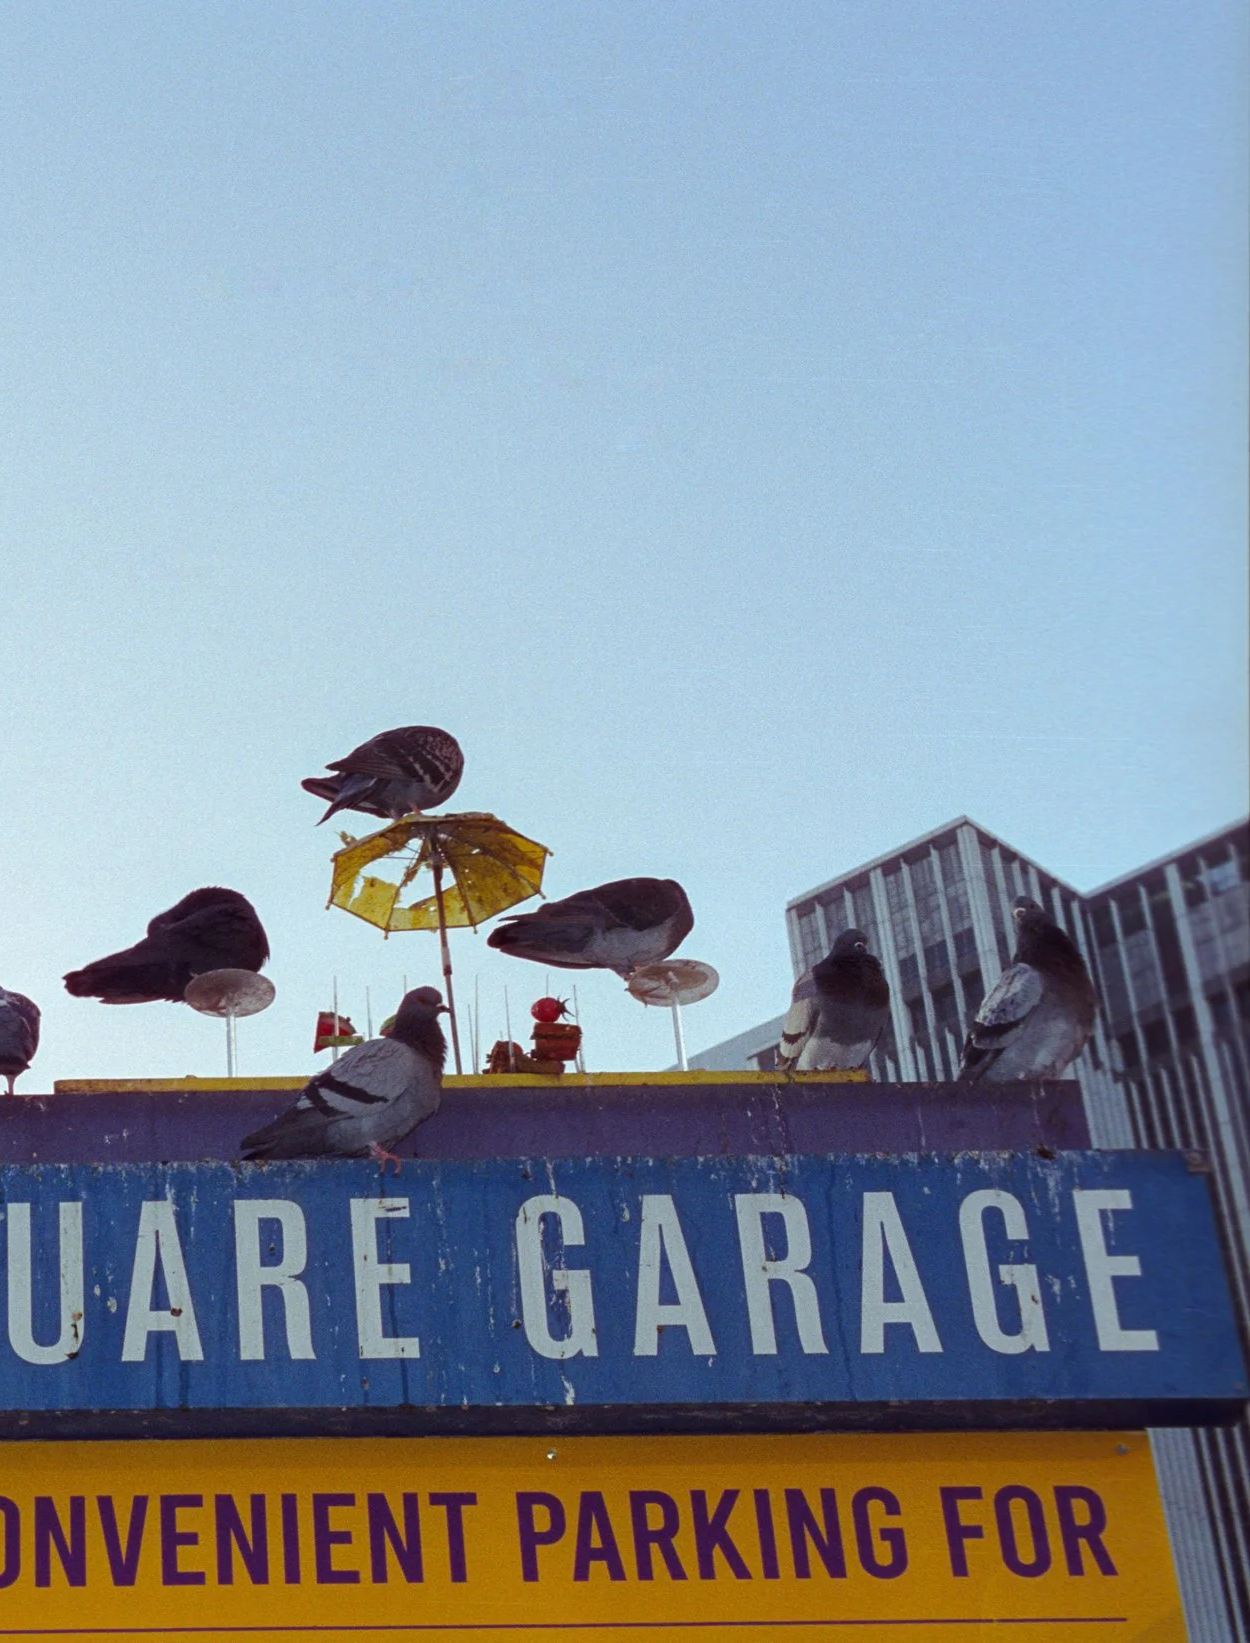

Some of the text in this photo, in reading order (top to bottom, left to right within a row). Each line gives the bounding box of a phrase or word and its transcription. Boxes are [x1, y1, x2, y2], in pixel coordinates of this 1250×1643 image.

[515, 1189, 1160, 1360] GARAGE
[516, 1485, 909, 1583] PARKING
[938, 1484, 1118, 1577] FOR
